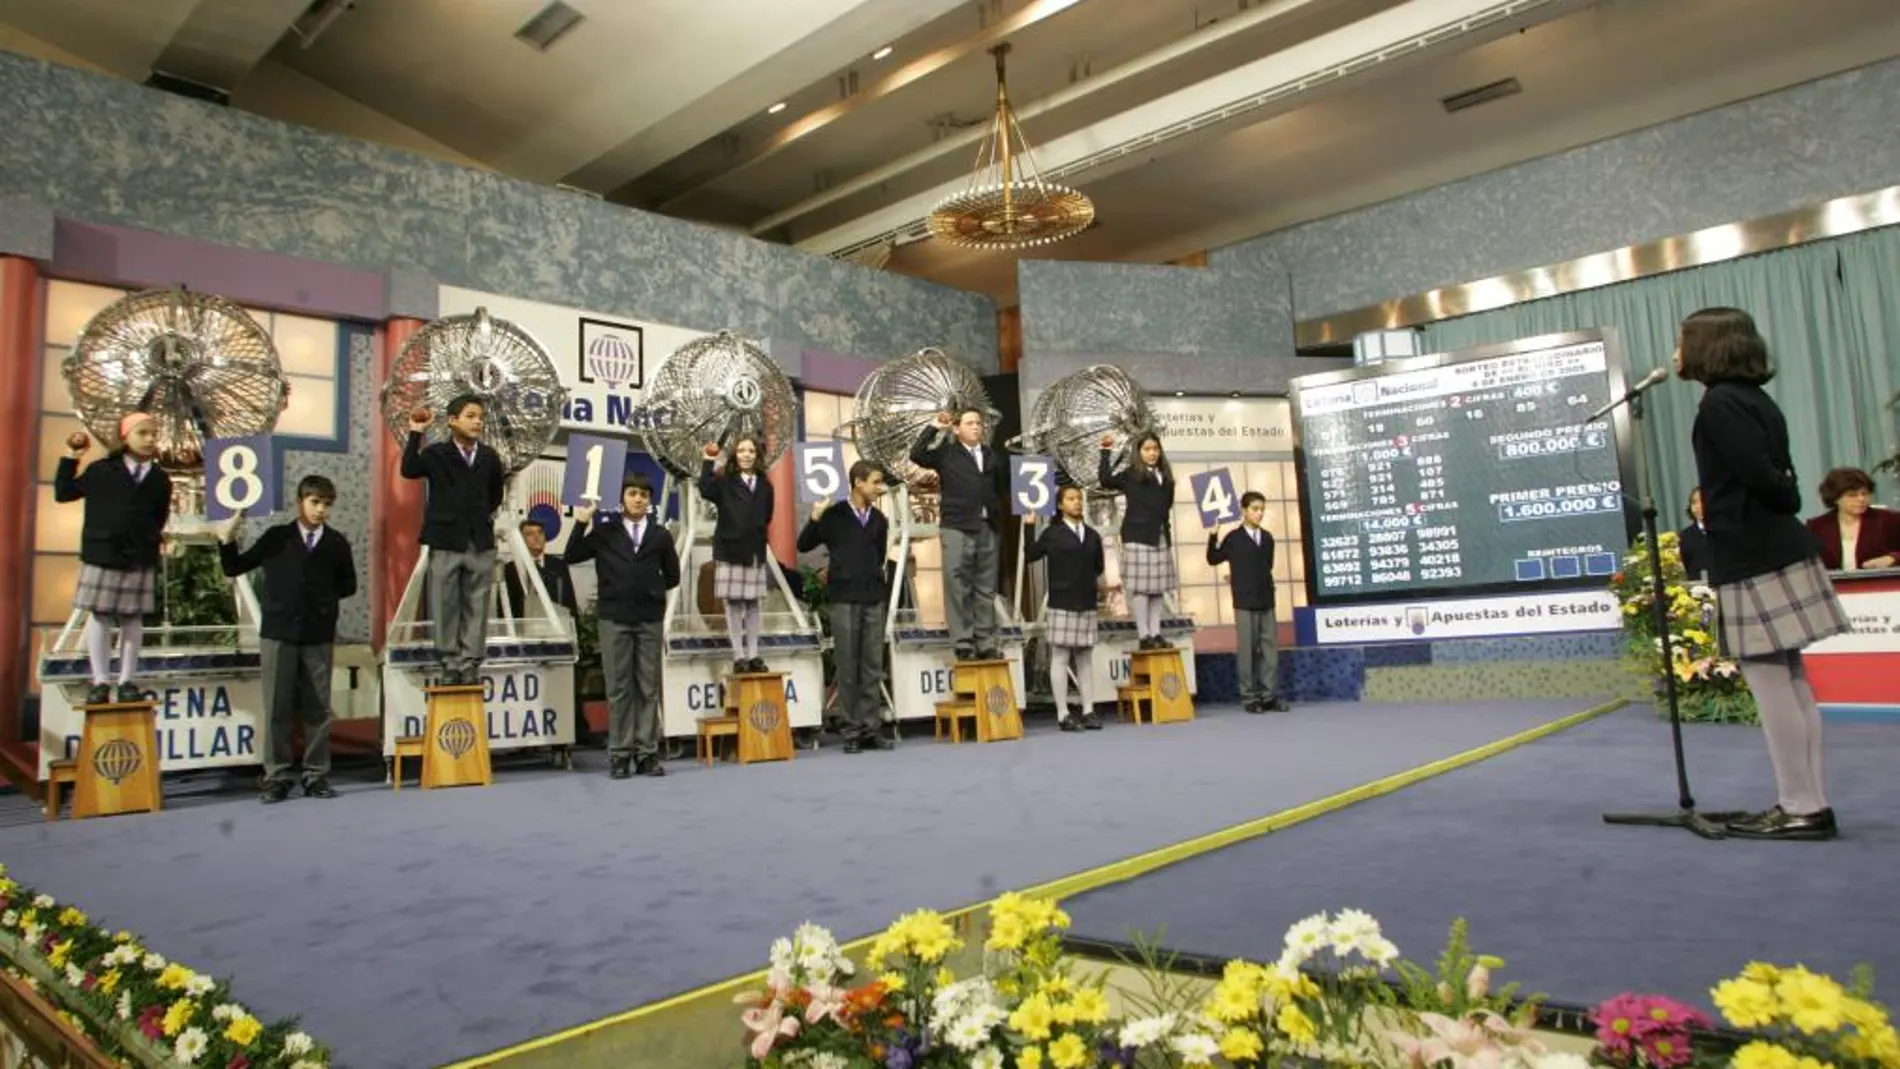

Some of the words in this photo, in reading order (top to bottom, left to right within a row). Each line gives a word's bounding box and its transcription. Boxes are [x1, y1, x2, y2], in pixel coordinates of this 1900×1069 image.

[1162, 427, 1215, 439] puestas
[1242, 427, 1285, 437] Estado
[1490, 429, 1552, 445] SEGUNDO
[216, 445, 263, 509] 8
[580, 444, 604, 501] 1
[804, 447, 840, 496] 5
[1018, 462, 1050, 510] 3
[1202, 476, 1233, 519] 4
[1490, 488, 1550, 504] PRIMER
[1504, 497, 1597, 518] 1.600.000
[1363, 516, 1409, 530] 14.000
[1394, 615, 1404, 629] y
[1432, 609, 1509, 624] Apuestas
[1516, 604, 1541, 619] del
[1550, 602, 1611, 616] Estado
[488, 708, 557, 740] LLAR
[155, 724, 254, 760] ILLAR
